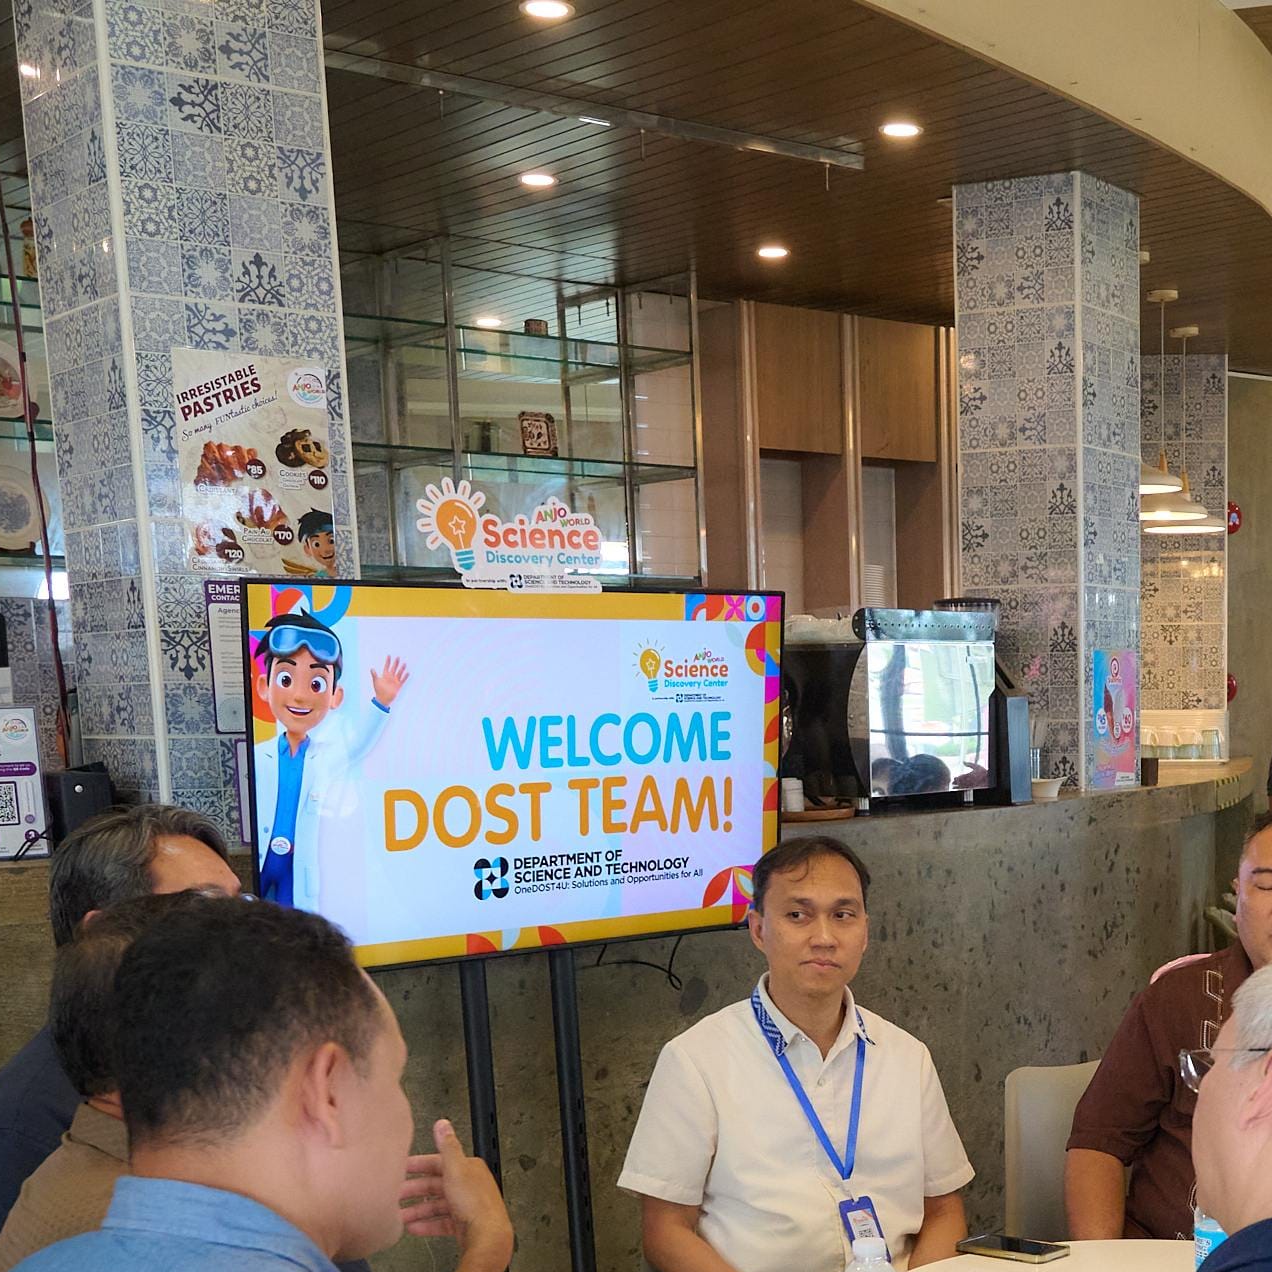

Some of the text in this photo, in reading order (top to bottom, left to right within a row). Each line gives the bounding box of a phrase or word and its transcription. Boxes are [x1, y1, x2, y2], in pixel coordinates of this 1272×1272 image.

[176, 364, 257, 404] IRRESISTABLE
[180, 377, 262, 421] PASTRIES
[182, 391, 278, 441] So many FUNtastic choices!
[482, 519, 599, 550] Science
[560, 517, 590, 528] WORLD
[485, 551, 600, 567] Discovery Center
[208, 584, 241, 595] EMER
[218, 607, 240, 615] Agenc
[664, 659, 729, 678] Science
[664, 679, 702, 689] Discovery
[482, 711, 732, 771] WELCOME
[384, 775, 733, 852] DOST TEAM!
[514, 850, 623, 870] DEPARTMENT OF
[514, 857, 690, 884] SCIENCE AND TECHNOLOGY
[514, 868, 703, 895] OneDOST4U: Solutions and Opportunities for All
